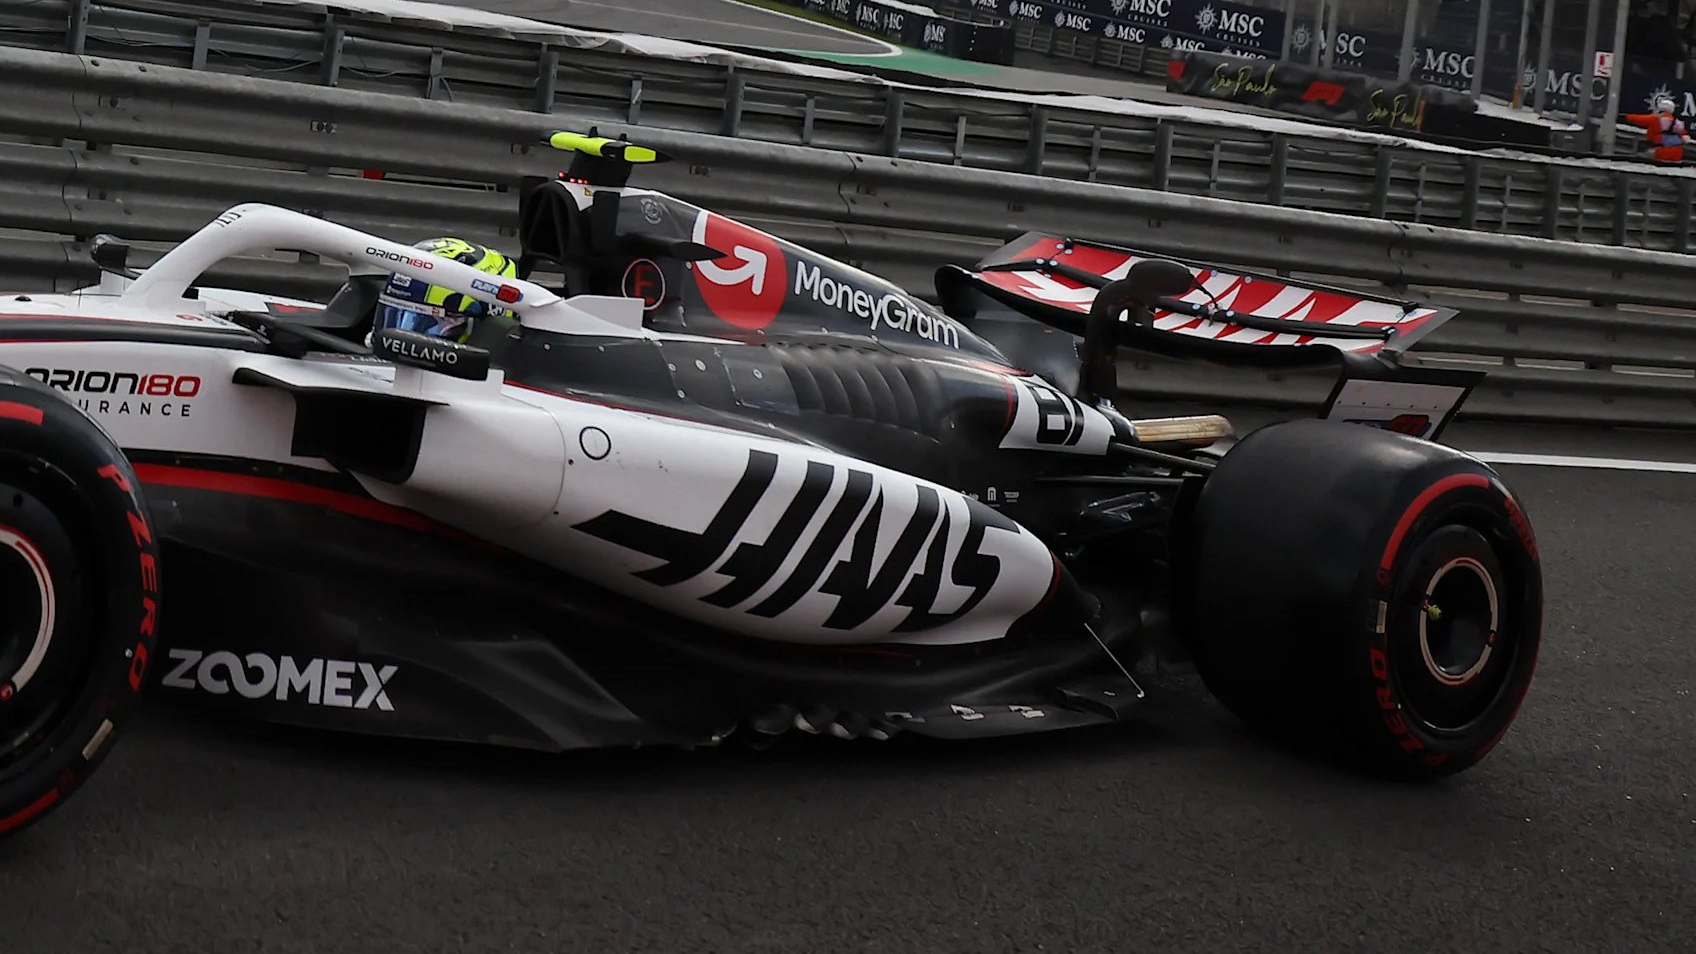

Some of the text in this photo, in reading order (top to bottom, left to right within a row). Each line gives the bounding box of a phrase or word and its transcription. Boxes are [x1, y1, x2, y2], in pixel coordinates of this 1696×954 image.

[1019, 2, 1042, 19] MSC
[1066, 13, 1091, 31] MSC
[1128, 14, 1168, 27] CRUISES
[1117, 26, 1145, 43] MSC
[1218, 10, 1264, 37] MSC
[1176, 37, 1205, 51] MSC
[1216, 32, 1261, 47] CRUISES
[1423, 48, 1475, 78] MSC
[365, 247, 434, 270] ORION180
[635, 265, 656, 304] E
[794, 260, 960, 349] MoneyGram
[382, 336, 458, 365] VELLAMO
[25, 368, 201, 397] ORION180
[78, 399, 192, 417] URANCE
[96, 464, 158, 692] P ZERO
[162, 648, 400, 712] ZOOMEX
